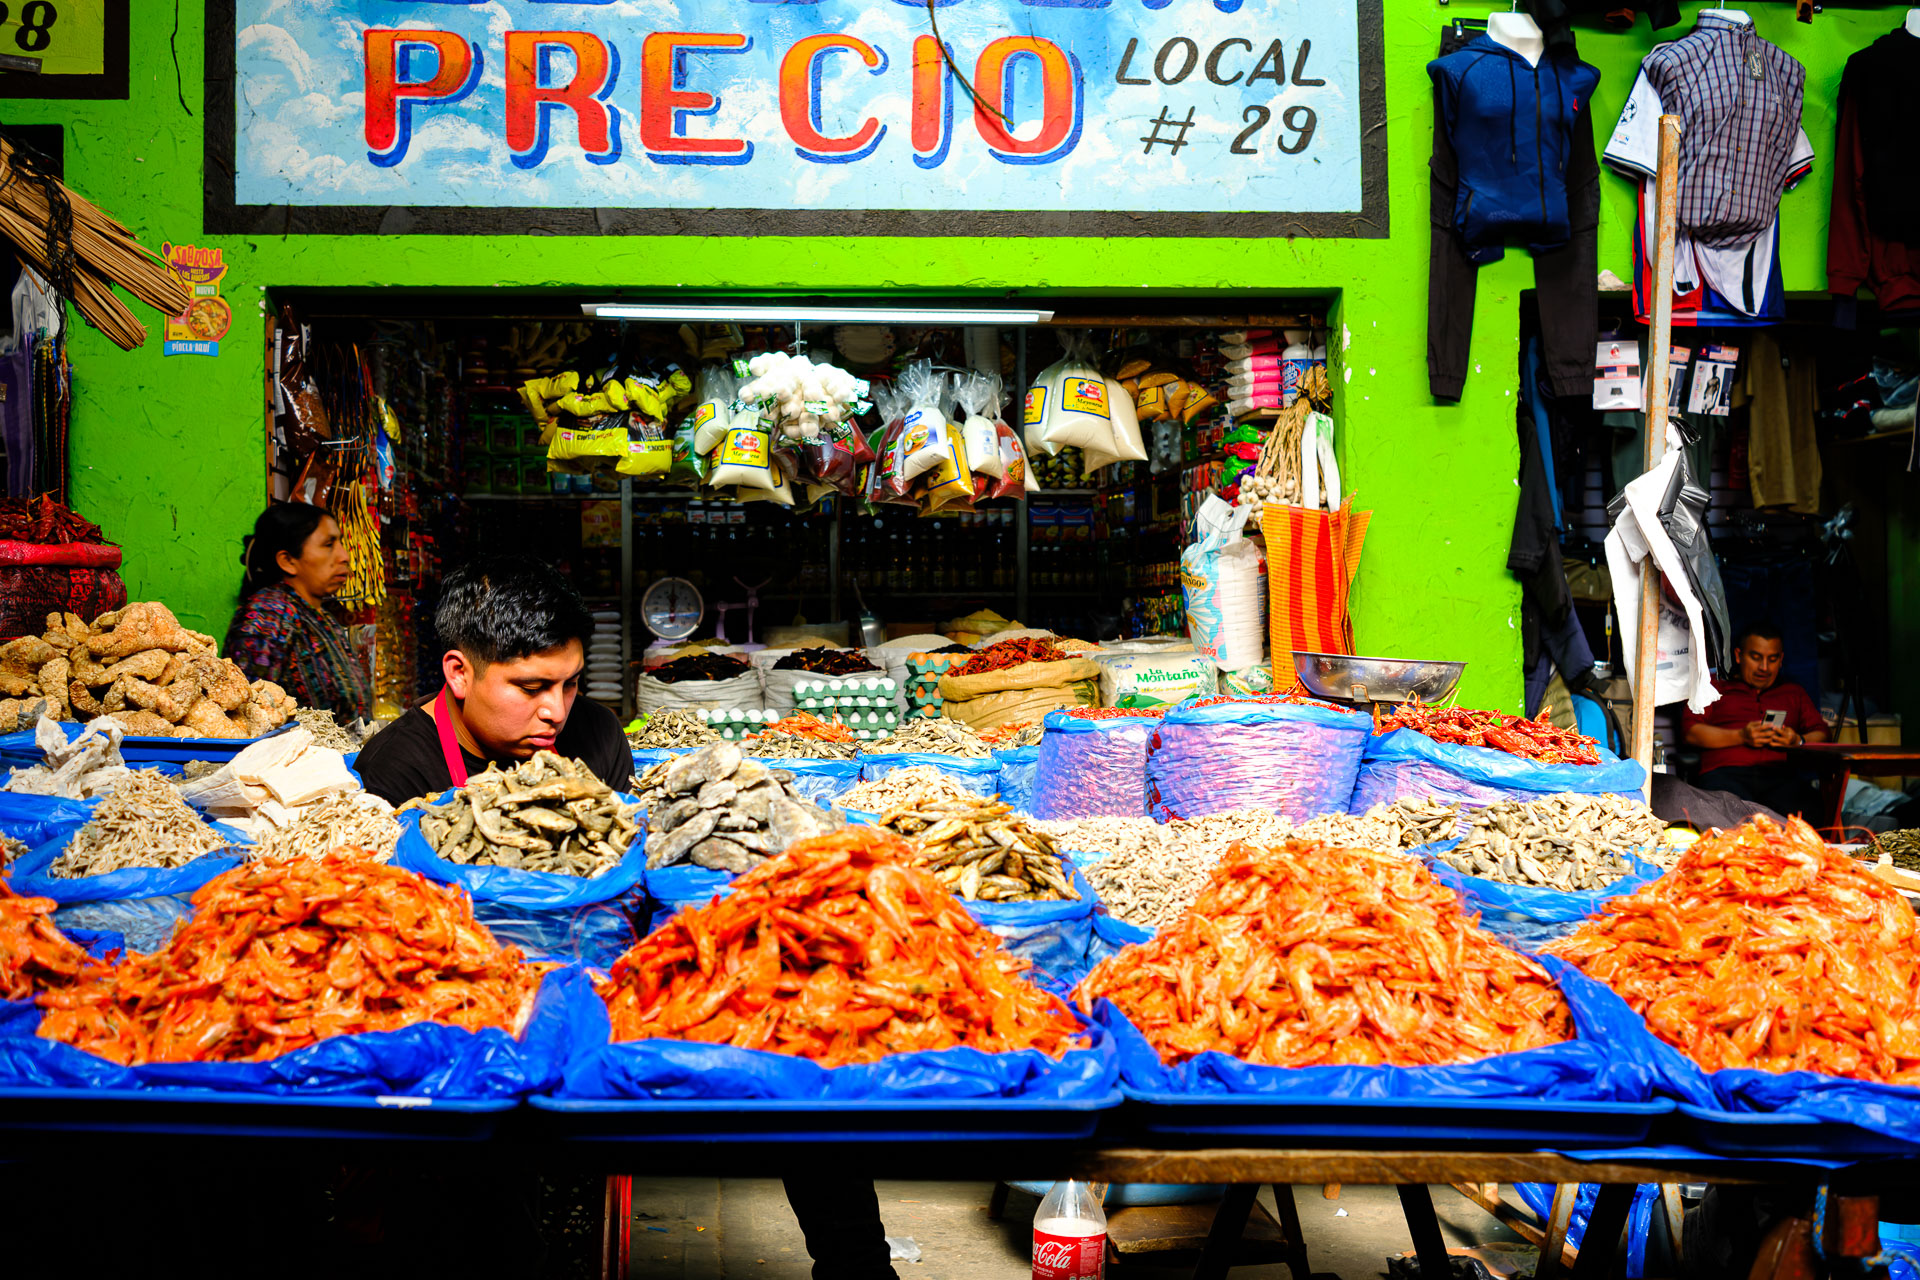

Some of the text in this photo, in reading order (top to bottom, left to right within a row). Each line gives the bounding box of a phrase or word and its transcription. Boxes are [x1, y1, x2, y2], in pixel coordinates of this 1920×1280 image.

[1115, 36, 1326, 87] LOCAL
[364, 29, 1083, 169] PRECIO
[1140, 104, 1318, 156] # 29
[175, 245, 222, 268] SABROSA
[1136, 669, 1200, 683] Montaña
